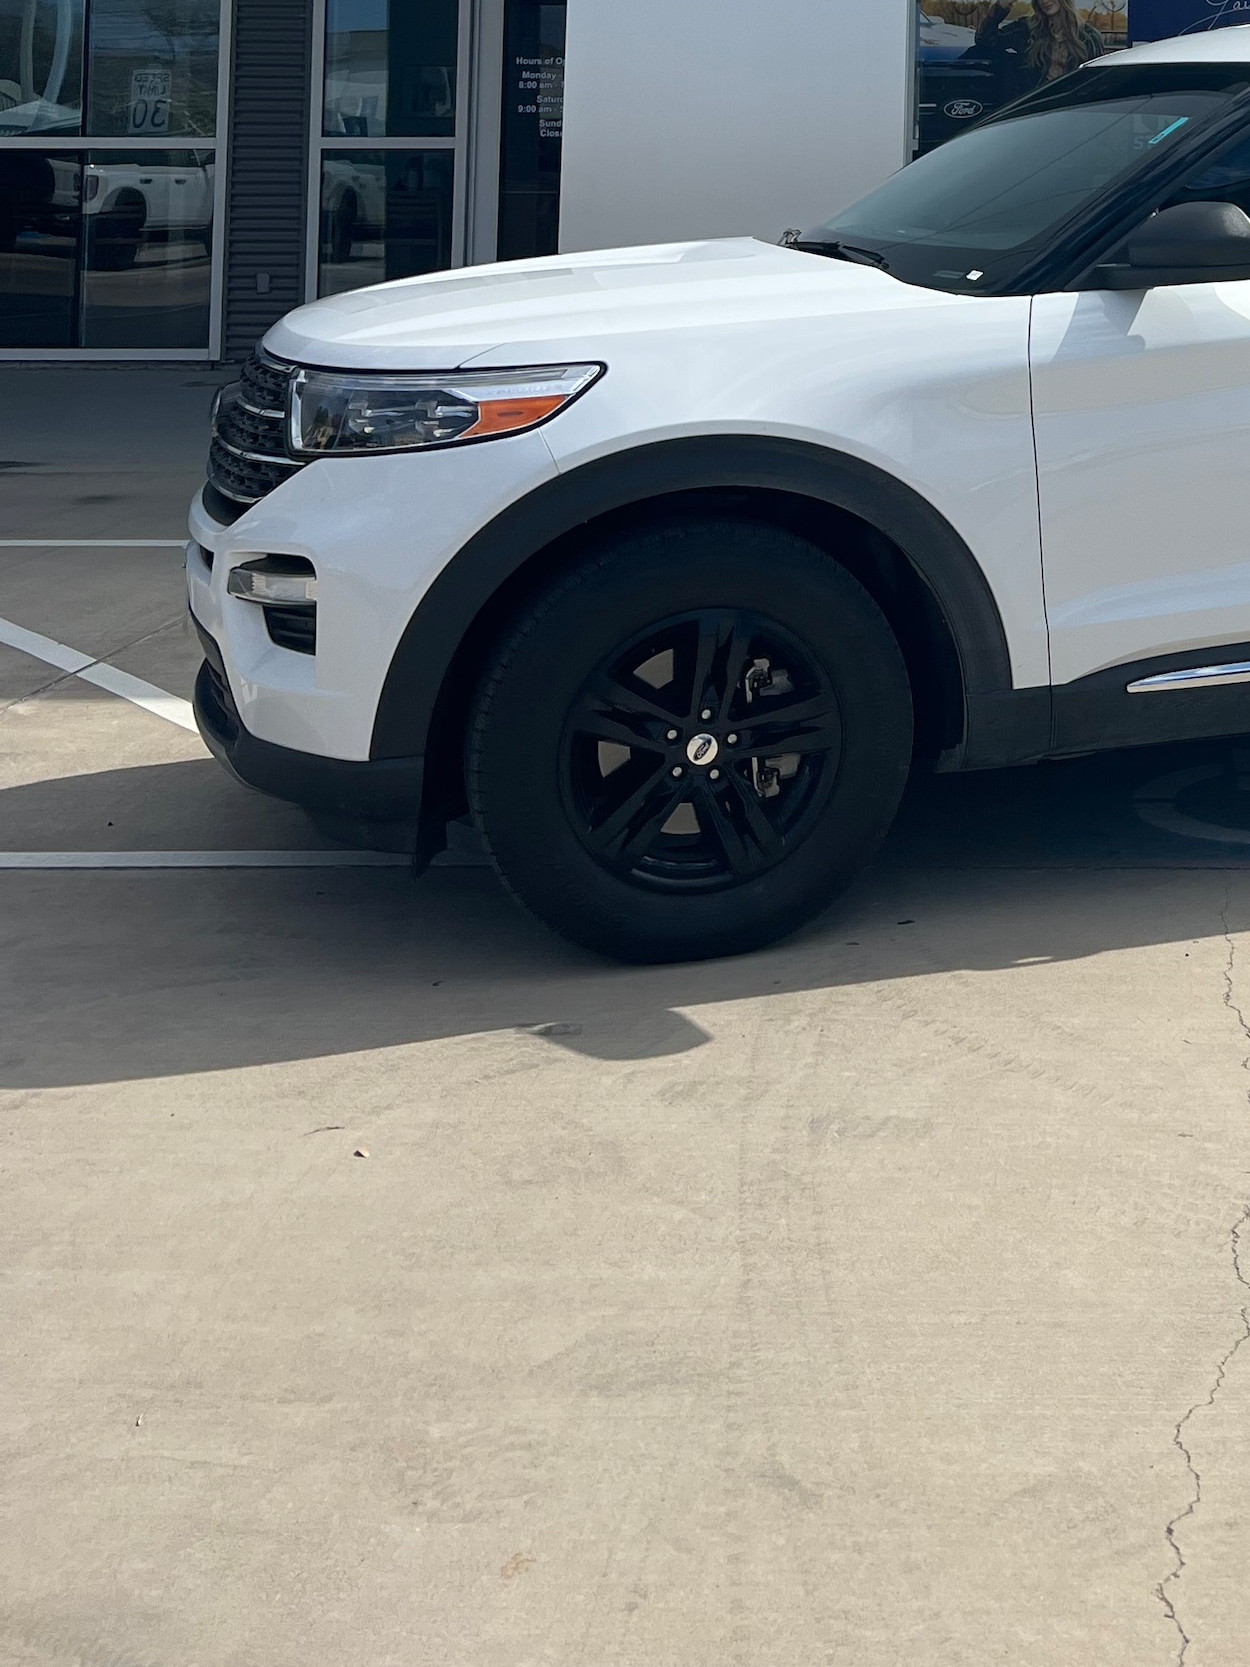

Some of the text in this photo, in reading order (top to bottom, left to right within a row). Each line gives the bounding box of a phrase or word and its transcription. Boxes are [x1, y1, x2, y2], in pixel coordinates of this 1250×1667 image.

[515, 56, 542, 65] Hours
[544, 56, 554, 65] of
[522, 71, 557, 80] Monday
[518, 81, 537, 89] 8:00
[517, 105, 537, 113] 9:00
[951, 102, 977, 115] Ford
[539, 119, 563, 127] Sund
